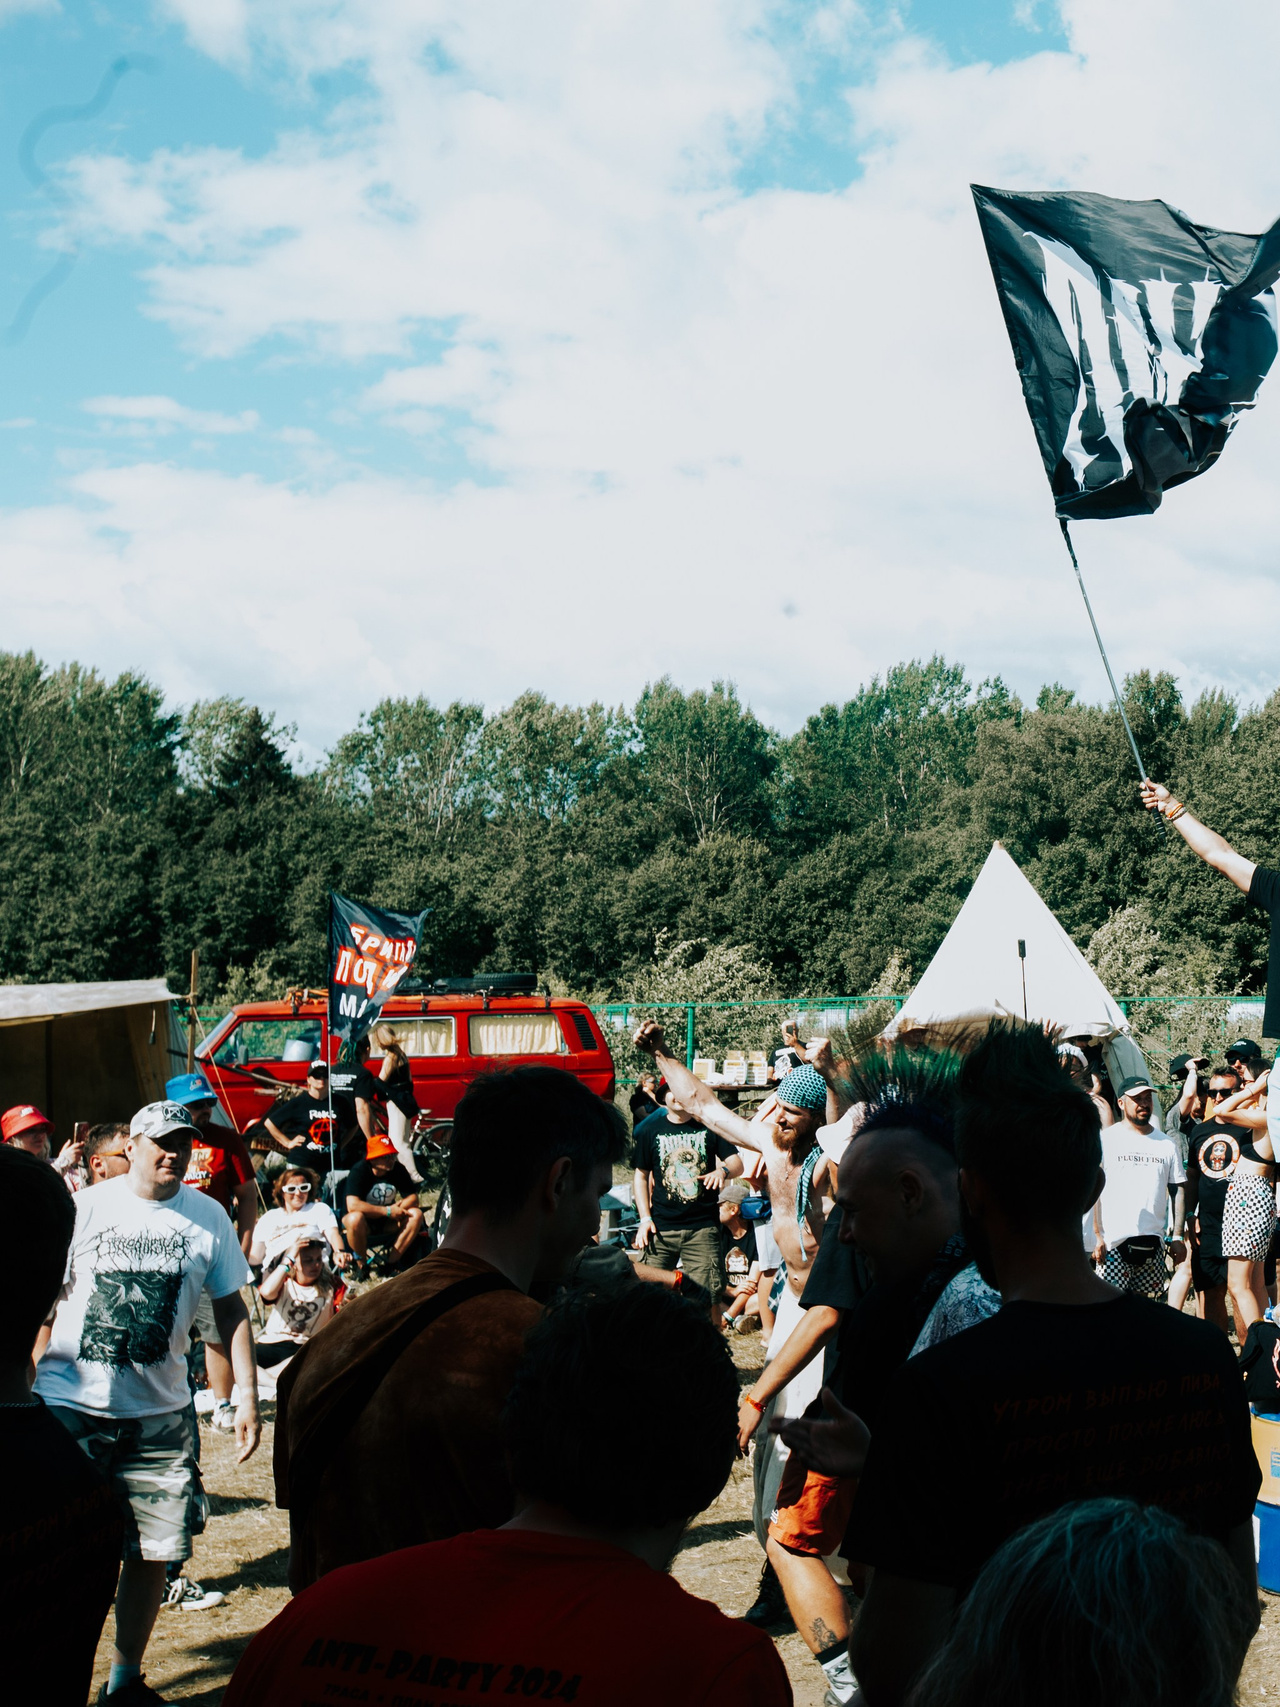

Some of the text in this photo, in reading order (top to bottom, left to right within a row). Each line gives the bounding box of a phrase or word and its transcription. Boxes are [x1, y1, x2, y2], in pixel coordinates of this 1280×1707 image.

[1117, 1155, 1144, 1163] PLUSH
[1146, 1156, 1166, 1165] FISH
[302, 1638, 583, 1703] ANTI-PARTY 2024
